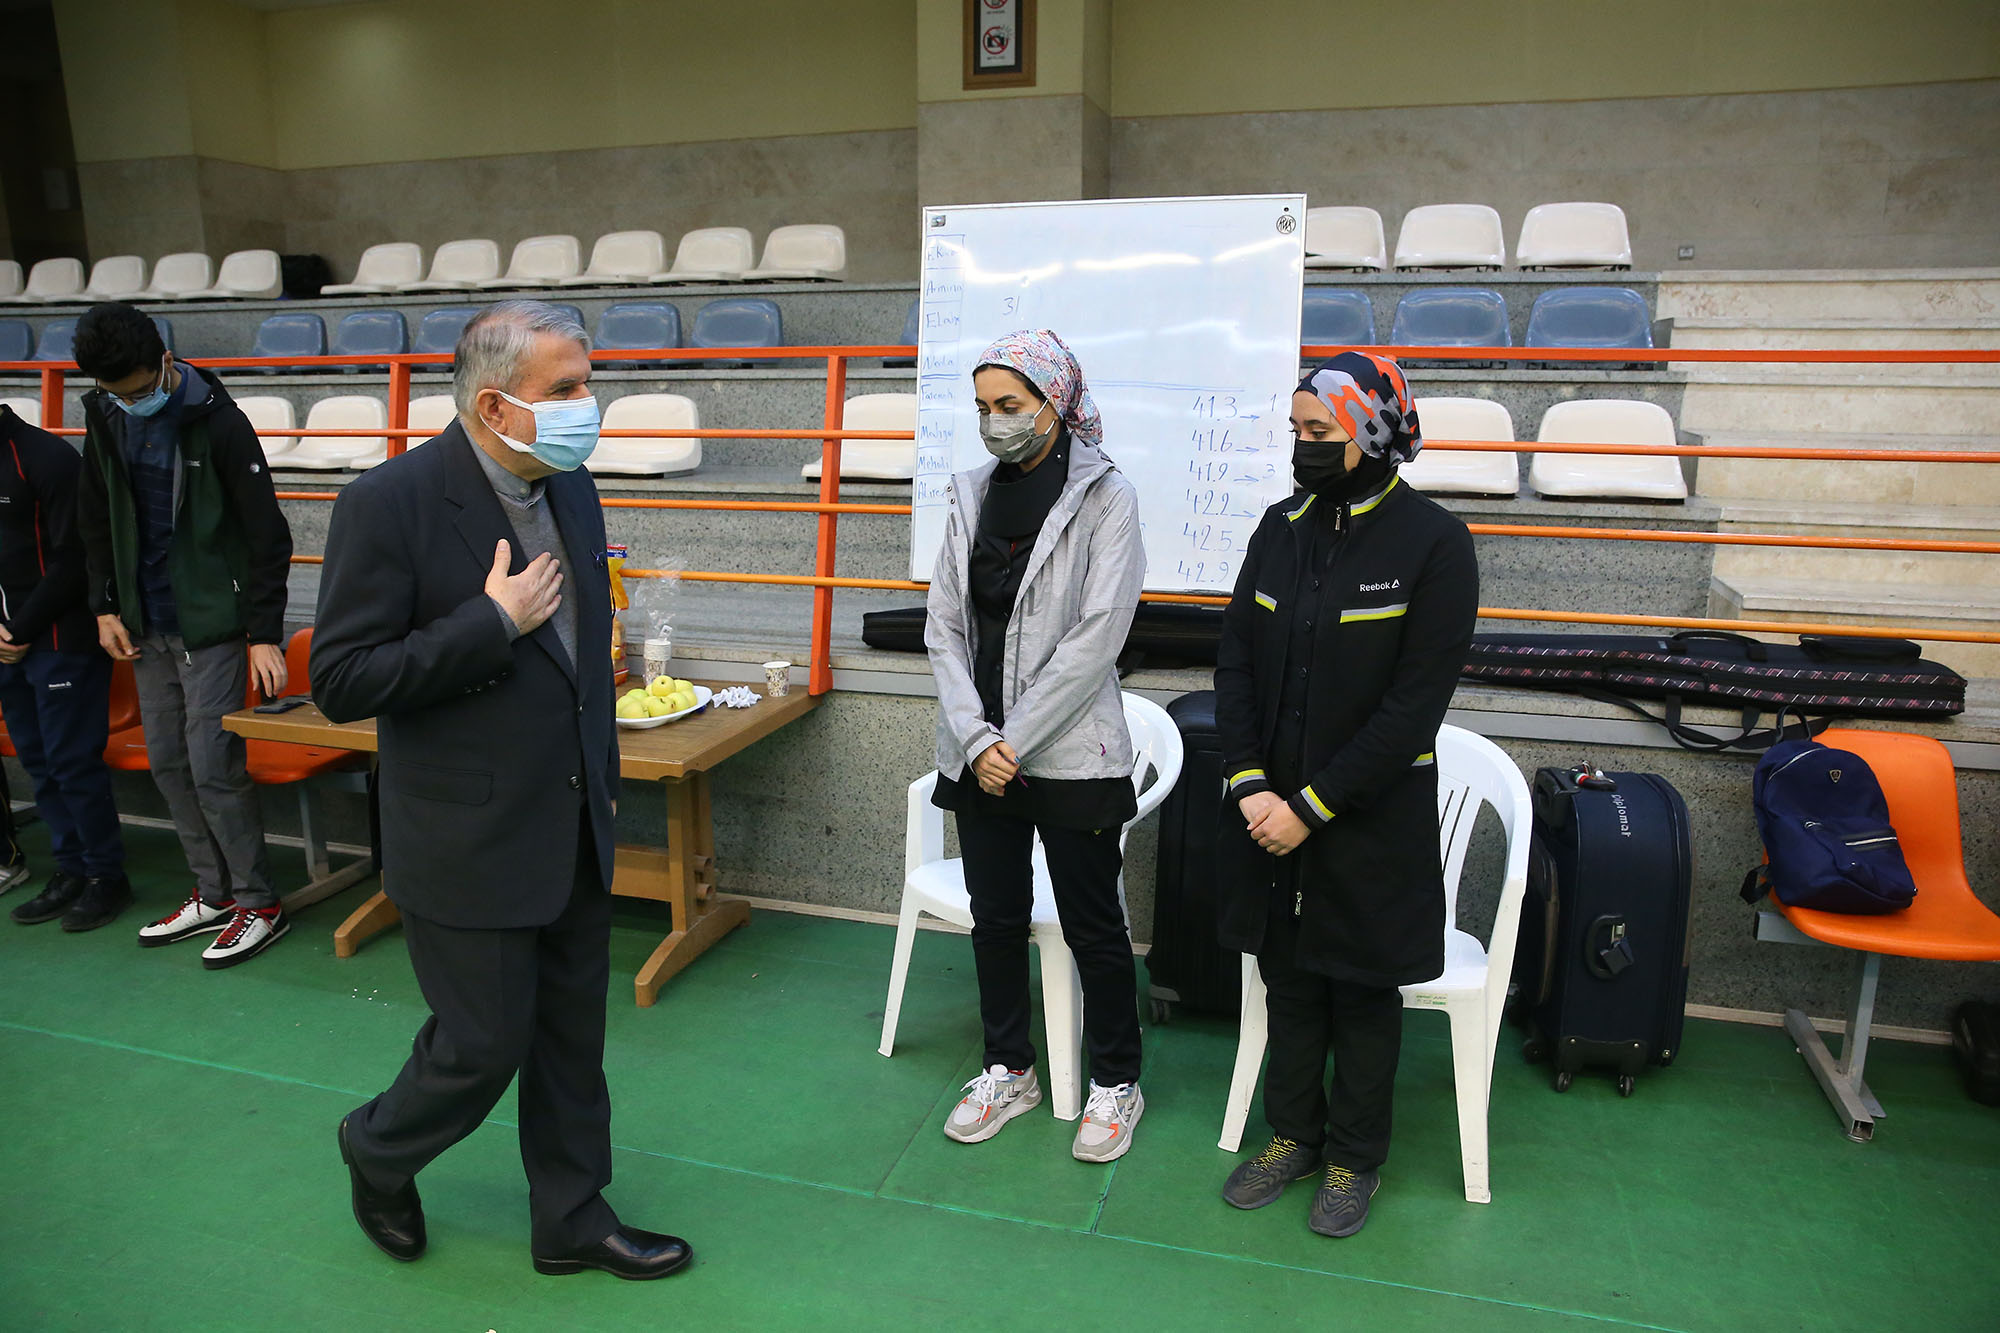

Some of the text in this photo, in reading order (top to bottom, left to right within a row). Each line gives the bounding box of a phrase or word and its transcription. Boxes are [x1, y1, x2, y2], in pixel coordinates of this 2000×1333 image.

[1192, 393, 1277, 422] 41.3 1
[1191, 428, 1278, 452] 41.6 2
[1188, 459, 1276, 482] 41.9 3
[1185, 488, 1230, 516] 42.2
[1183, 522, 1233, 552] 42.5
[1177, 560, 1230, 583] 42.9
[1359, 581, 1391, 592] Reebok
